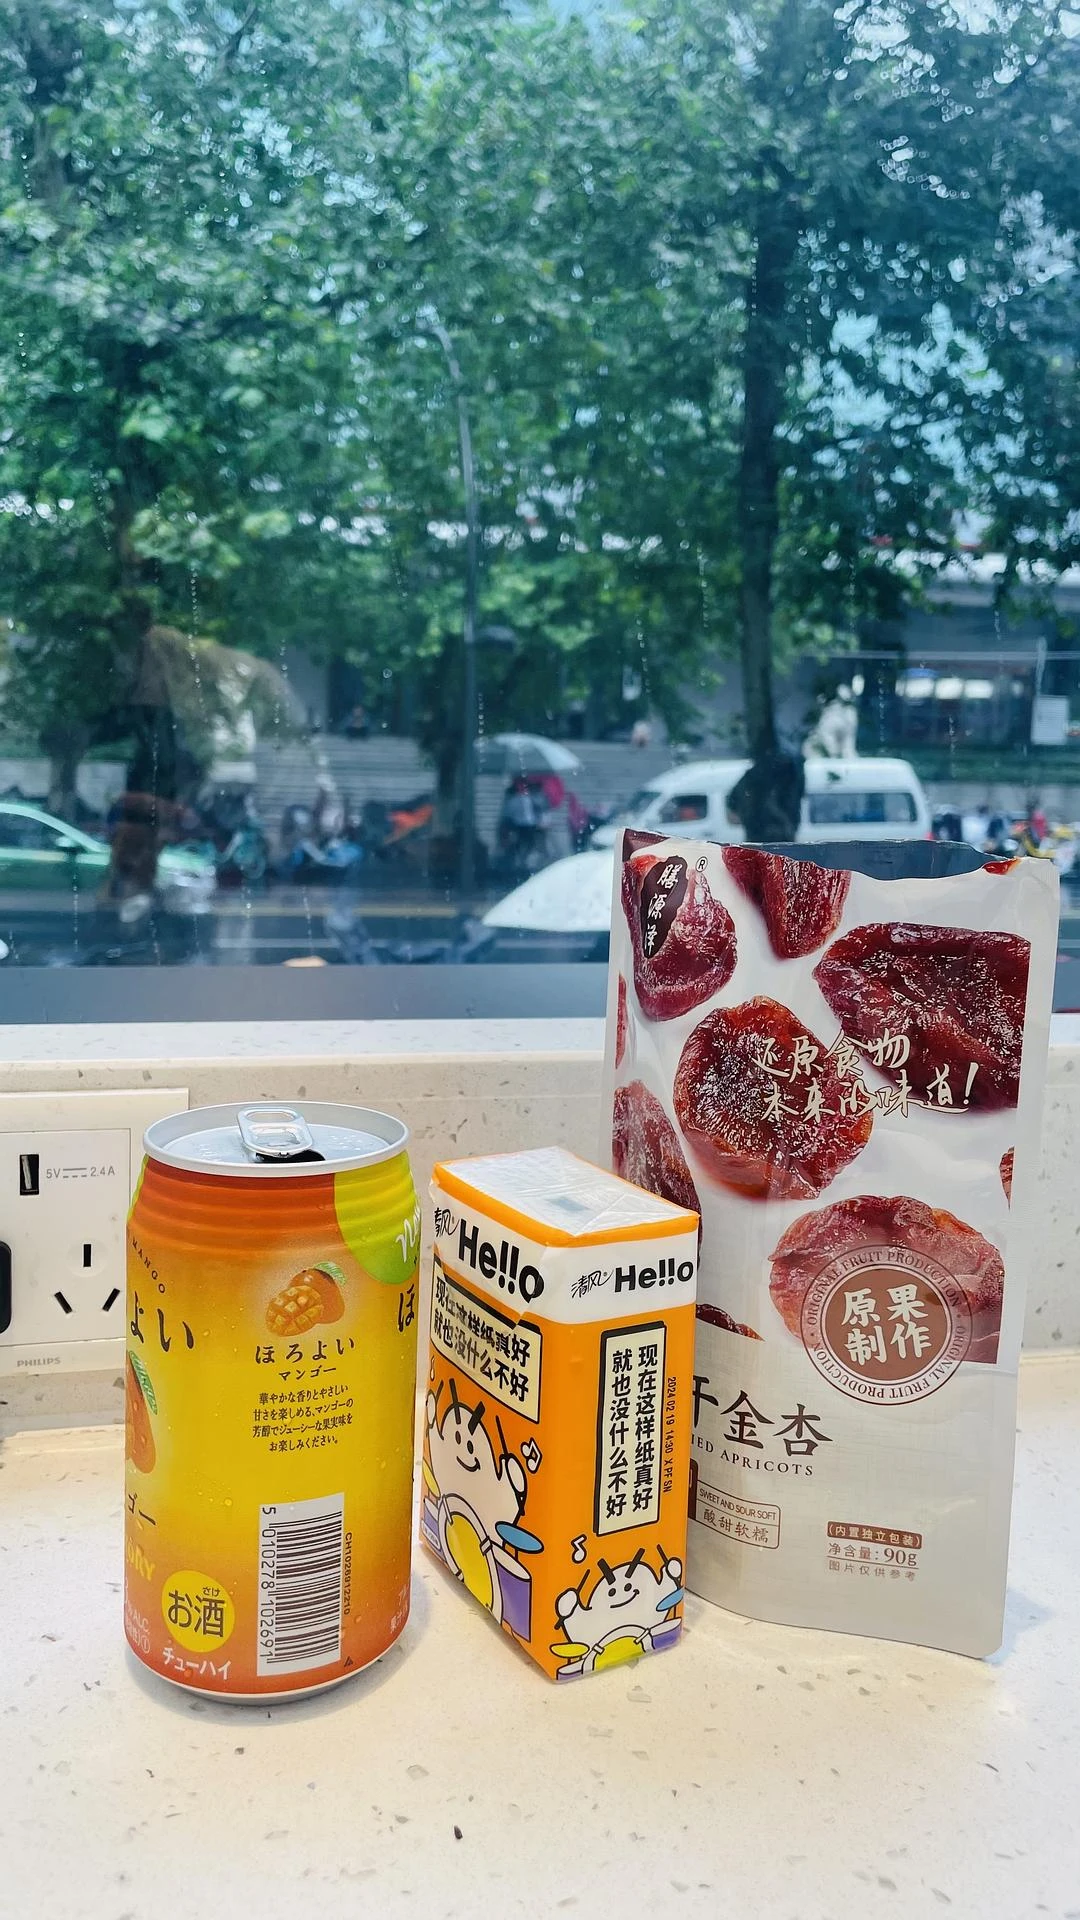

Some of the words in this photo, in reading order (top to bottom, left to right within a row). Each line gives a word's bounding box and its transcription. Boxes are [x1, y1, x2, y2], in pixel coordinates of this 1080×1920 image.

[751, 1028, 911, 1083] 还原食物
[90, 1166, 115, 1177] 2.4A
[571, 1269, 615, 1299] 清风
[807, 1268, 842, 1326] ORIGINAL
[843, 1251, 883, 1271] FRUIT
[887, 1251, 962, 1308] PRODUCTION
[16, 1356, 61, 1368] PHILIPS
[255, 1338, 355, 1364] ほろよい
[433, 1308, 530, 1402] 就也没什么不好
[930, 1325, 967, 1382] ORIGINAL
[278, 1364, 337, 1381] マンゴー
[809, 1341, 885, 1399] PRODUCTION
[259, 1385, 348, 1405] 華やかな香りとやさしい
[667, 1376, 676, 1399] 2024
[889, 1380, 931, 1400] FRUIT
[253, 1398, 354, 1421] 甘さを楽しめる、マンゴーの
[665, 1414, 674, 1425] 19
[666, 1400, 675, 1413] 02
[606, 1348, 633, 1519] 就也没什么不好
[632, 1343, 658, 1513] 现在这样纸真好
[269, 1435, 338, 1453] お楽しみください。
[664, 1430, 674, 1454] 14:30
[720, 1449, 814, 1476] APRICOTS
[262, 1506, 276, 1515] 5
[699, 1488, 720, 1505] SWEET
[720, 1499, 735, 1511] AND
[735, 1504, 756, 1518] SOUR
[756, 1509, 777, 1521] SOFT
[703, 1508, 769, 1543] 酸甜软糯
[260, 1528, 276, 1590] 010278
[202, 1586, 220, 1597] さけ
[167, 1589, 226, 1639] お酒
[260, 1599, 275, 1658] 102691
[161, 1647, 232, 1680] チューハイ
